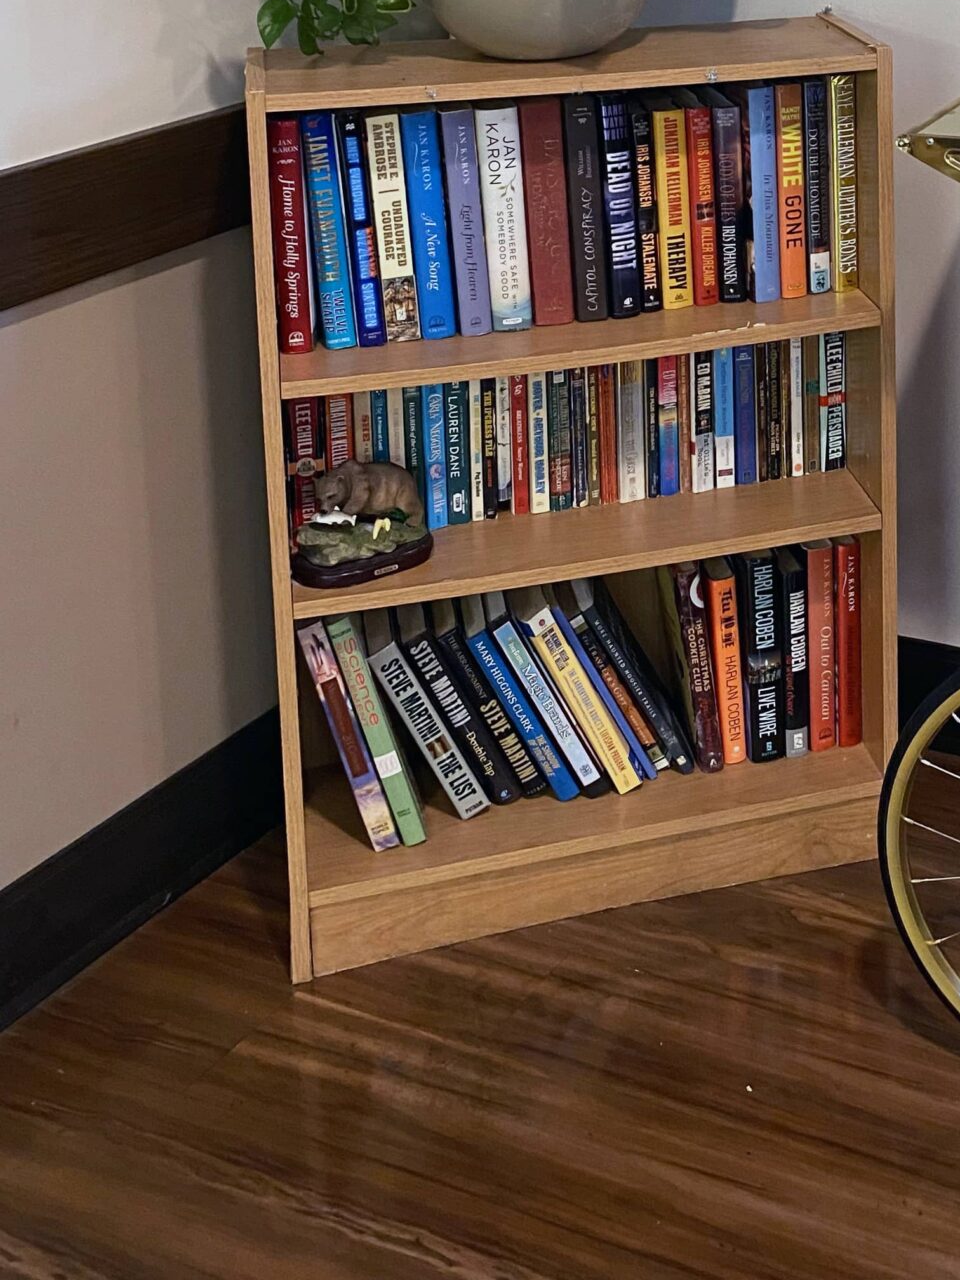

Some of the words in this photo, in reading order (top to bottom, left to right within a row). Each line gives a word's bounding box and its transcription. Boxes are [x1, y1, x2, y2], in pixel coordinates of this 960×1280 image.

[272, 145, 298, 153] KARON
[278, 138, 292, 146] JAN
[346, 136, 360, 164] JANET
[372, 123, 388, 181] AMBROSE
[384, 121, 399, 173] STEPHEN
[418, 124, 429, 146] JAN
[458, 124, 468, 144] JAN
[503, 137, 517, 169] JAN
[636, 144, 649, 161] IRIS
[663, 116, 680, 168] JONATHAN
[697, 138, 709, 155] IRIS
[808, 128, 819, 173] DOUBLE
[837, 116, 856, 181] KELLERMAN
[309, 135, 331, 182] JANET
[421, 147, 432, 191] KARON
[461, 146, 471, 185] KARON
[485, 122, 502, 186] KARON
[606, 151, 631, 193] DEAD
[719, 152, 733, 181] BODY
[781, 123, 802, 188] WHITE
[277, 175, 296, 218] Home
[349, 168, 366, 221] EVANOVICH
[638, 164, 652, 208] JOHANSEN
[666, 171, 683, 227] KELLERMAN
[699, 158, 712, 202] JOHANSEN
[721, 183, 734, 198] OF
[286, 221, 295, 233] to
[459, 204, 473, 231] Light
[581, 188, 595, 261] CONSPIRACY
[610, 200, 633, 216] OF
[721, 201, 736, 222] LIES
[785, 195, 803, 250] GONE
[809, 179, 821, 239] HOMICIDE
[315, 189, 339, 283] EVANOVICH
[381, 210, 396, 262] COURAGE
[391, 200, 408, 268] UNDAUNTED
[426, 229, 439, 257] New
[461, 231, 475, 257] from
[496, 211, 507, 266] SOMEBODY
[506, 197, 517, 262] SOMEWHERE
[611, 220, 637, 270] NIGHT
[701, 226, 713, 252] KILLER
[722, 225, 736, 241] IRIS
[281, 230, 299, 273] Holly
[641, 233, 657, 290] STALEMATE
[667, 232, 688, 291] THERAPY
[703, 254, 715, 287] DREAMS
[723, 242, 738, 285] JOHANSEN
[840, 238, 857, 274] BONES
[426, 259, 440, 291] Song
[463, 258, 478, 302] Heaven
[500, 271, 509, 300] GOOD
[510, 264, 519, 290] SAFE
[585, 265, 598, 312] CAPITOL
[283, 271, 300, 319] Springs
[320, 292, 335, 334] SHARP
[332, 288, 347, 335] TWELVE
[361, 282, 378, 328] SIXTEEN
[698, 362, 709, 373] ED
[826, 342, 843, 360] LEE
[698, 376, 711, 411] McBAIN
[828, 362, 844, 393] CHILD
[295, 403, 311, 422] LEE
[362, 414, 370, 442] SHE
[447, 396, 459, 442] LAUREN
[484, 406, 493, 438] IPCRESS
[298, 424, 312, 455] CHILD
[430, 418, 443, 462] NEGGERS
[485, 439, 494, 457] FILE
[533, 417, 545, 457] ARTHUR
[828, 406, 844, 460] PERSUADER
[450, 446, 460, 478] DANE
[474, 471, 482, 480] Peg
[535, 459, 545, 494] HAILEY
[847, 555, 855, 573] JAN
[720, 587, 733, 614] TELL
[753, 564, 774, 608] HARLAN
[824, 580, 832, 617] KARON
[848, 577, 856, 612] KARON
[695, 620, 703, 635] THE
[721, 615, 735, 629] NO
[754, 610, 775, 650] COBEN
[789, 590, 804, 632] HARLAN
[687, 627, 699, 664] COOKIE
[723, 633, 736, 648] ONE
[790, 636, 806, 673] COBEN
[820, 626, 832, 652] Out
[340, 636, 384, 727] Science
[447, 635, 460, 651] THE
[454, 649, 487, 700] ARRAIGNMENT
[592, 619, 608, 638] MORE
[604, 638, 626, 668] HAUNTED
[623, 668, 644, 696] HOOSIER
[640, 696, 657, 718] TRAILS
[691, 667, 703, 693] CLUB
[697, 637, 711, 692] CHRISTMAS
[725, 656, 738, 702] HARLAN
[821, 656, 831, 668] to
[378, 656, 415, 697] STEVE
[398, 690, 442, 743] MARTINI
[408, 639, 444, 681] STEVE
[429, 674, 471, 729] MARTINI
[474, 640, 496, 668] MARY
[489, 666, 518, 705] HIGGINS
[511, 702, 534, 733] CLARK
[516, 662, 550, 704] Magic
[540, 696, 572, 740] Brands
[757, 686, 776, 709] LIVE
[821, 670, 832, 721] Canaan
[478, 697, 511, 737] STEVE
[498, 731, 539, 784] MARTINI
[727, 703, 741, 742] COBEN
[758, 710, 777, 738] WIRE
[435, 751, 463, 779] THE
[465, 730, 489, 763] Double
[480, 760, 497, 779] Tap
[447, 772, 477, 803] LIST
